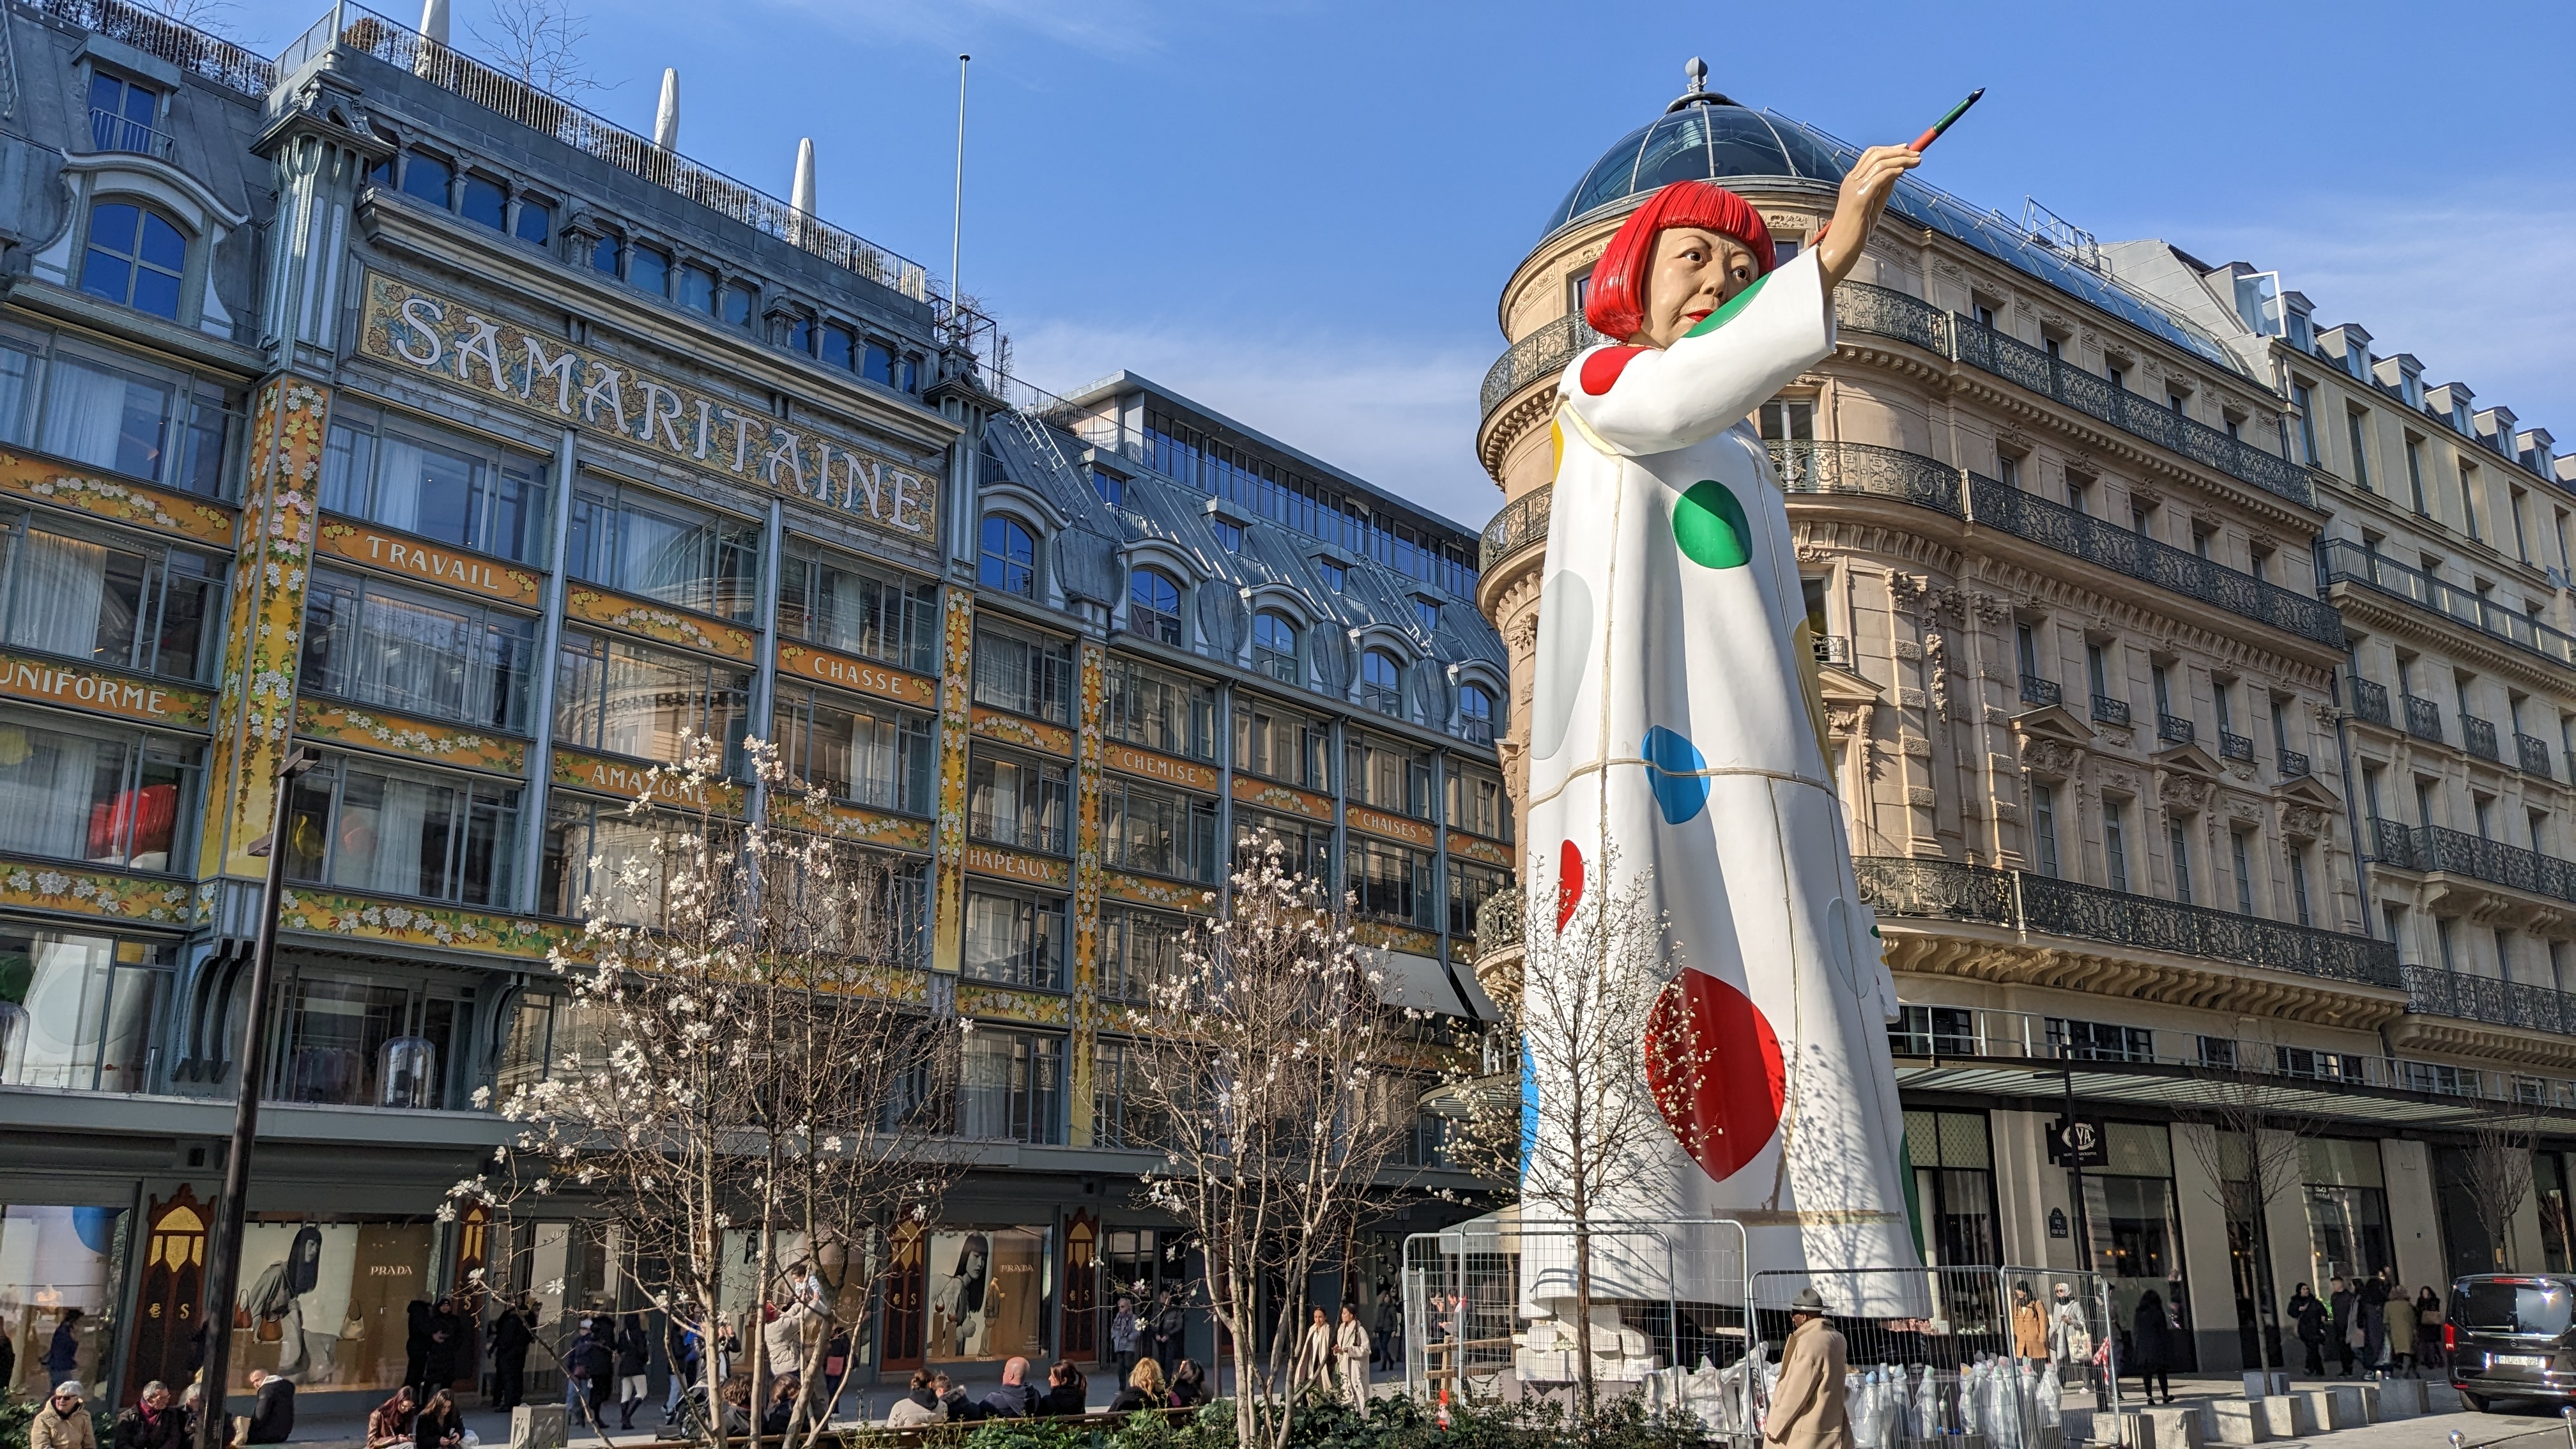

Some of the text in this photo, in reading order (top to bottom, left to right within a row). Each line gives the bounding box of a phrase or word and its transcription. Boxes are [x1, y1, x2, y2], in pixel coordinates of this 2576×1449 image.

[395, 296, 924, 533] SAMARITAINE
[365, 535, 498, 590] TRAVAIL
[0, 662, 167, 715] UNIFORME
[814, 657, 902, 694] CHASSE
[1124, 752, 1195, 783] CHEMISE
[1363, 813, 1416, 838] CHAISES
[966, 848, 1050, 879] HAPEAUX
[371, 1266, 413, 1275] PRADA
[180, 1303, 190, 1319] S
